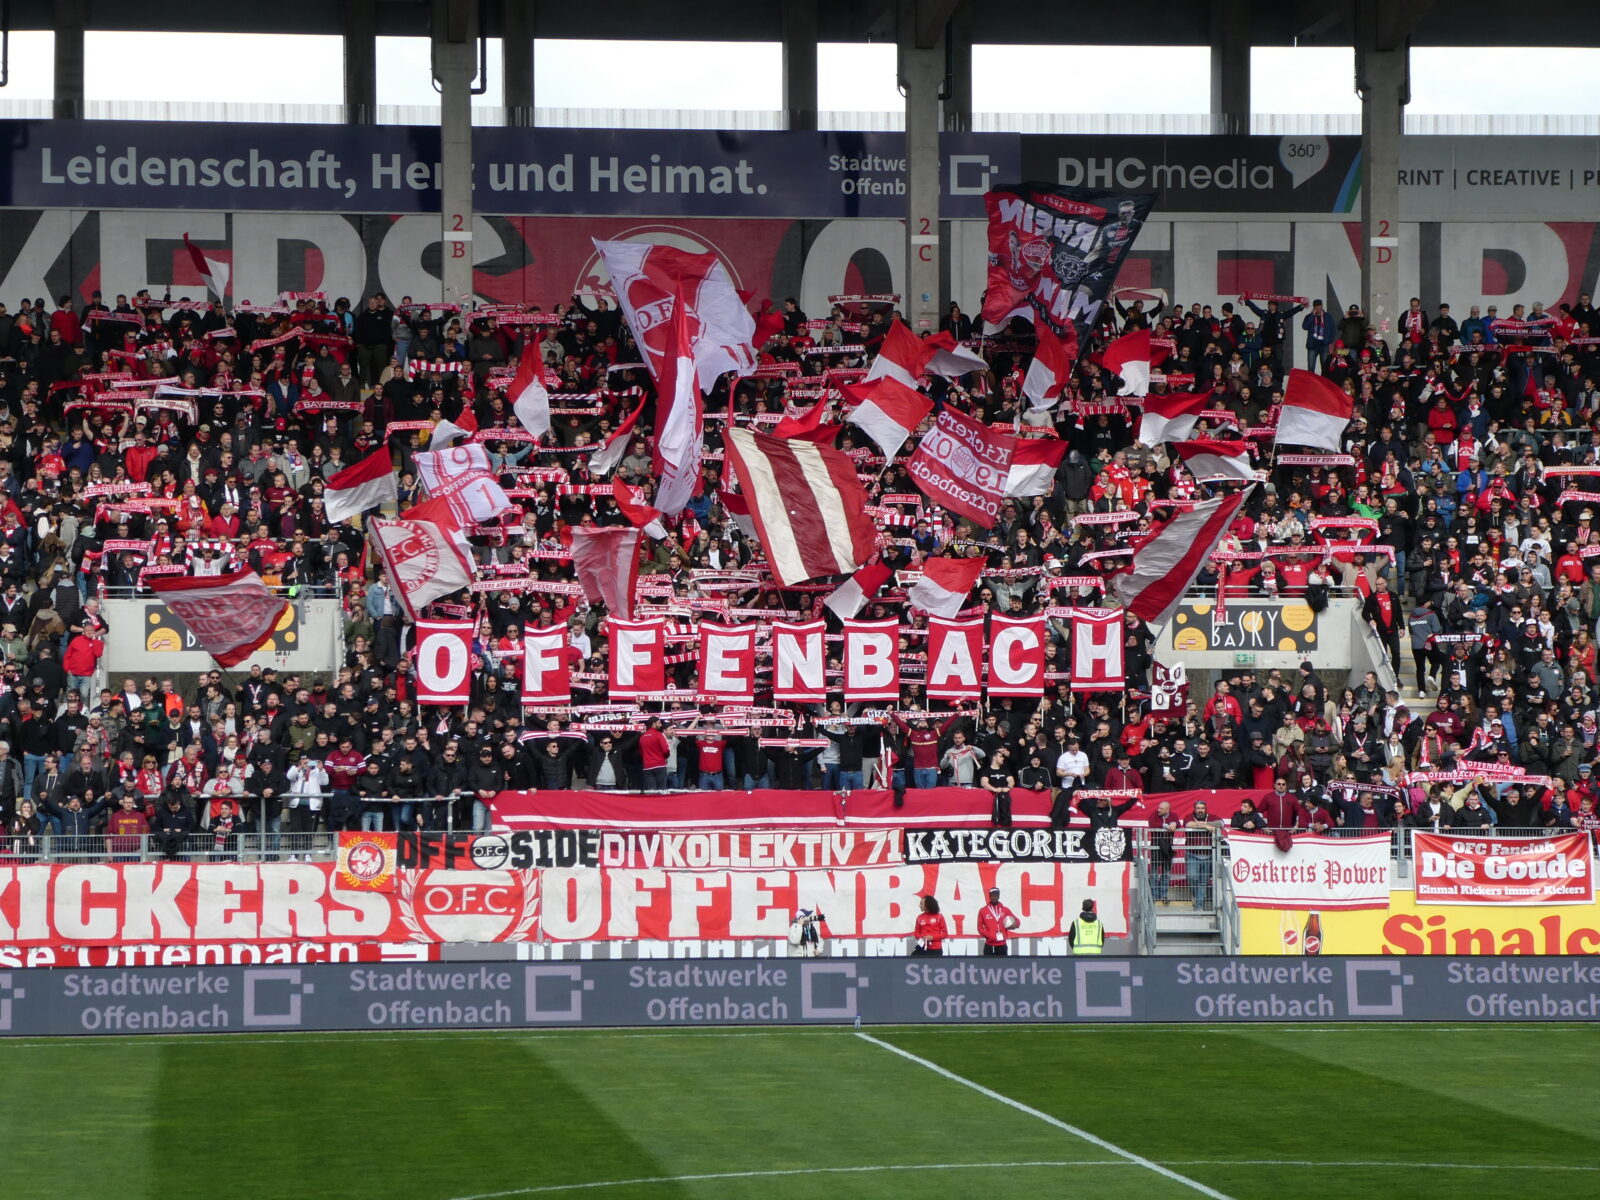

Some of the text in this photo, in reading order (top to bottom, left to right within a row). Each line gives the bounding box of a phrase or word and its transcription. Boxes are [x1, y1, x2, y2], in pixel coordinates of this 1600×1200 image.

[41, 145, 357, 199] Leidenschaft,
[489, 154, 574, 193] und
[590, 154, 768, 196] Heimat.
[828, 154, 940, 172] Stadtwe
[841, 178, 940, 197] Offenb
[1397, 169, 1444, 186] RINT
[1466, 168, 1561, 187] CREATIVE
[452, 213, 464, 232] 2
[919, 218, 931, 236] 2
[1378, 220, 1390, 238] 2
[451, 241, 465, 259] B
[918, 245, 932, 263] C
[1376, 247, 1392, 264] D
[303, 401, 336, 410] BAYER
[580, 723, 624, 731] KOLLEKTIV
[732, 719, 774, 727] KOLLEKTIV
[1428, 771, 1475, 779] OFFENBACH
[1467, 760, 1515, 772] OFFENBACH
[511, 830, 599, 868] SIDE
[662, 828, 902, 868] KOLLEKTIV 71
[906, 829, 1090, 861] KATEGORIE
[1452, 841, 1556, 857] OFC Fanclub
[1232, 857, 1387, 889] Ostkreis Power
[1421, 851, 1587, 880] Die Goude
[0, 862, 1126, 941] ICKERS O.F.C. OFFENBACH
[1418, 884, 1586, 896] Einmal Kickers immer Kickers
[63, 970, 230, 997] Stadtwerke
[350, 967, 512, 992] Stadtwerke
[629, 964, 788, 988] Stadtwerke
[905, 961, 1063, 986] Stadtwerke
[1176, 960, 1334, 985] Stadtwerke
[1447, 960, 1600, 985] Stadtwerke
[81, 1004, 229, 1030] Offenbach
[367, 999, 512, 1025] Offenbach
[647, 997, 788, 1021] Offenbach
[922, 994, 1063, 1019] Offenbach
[1195, 993, 1335, 1018] Offenbach
